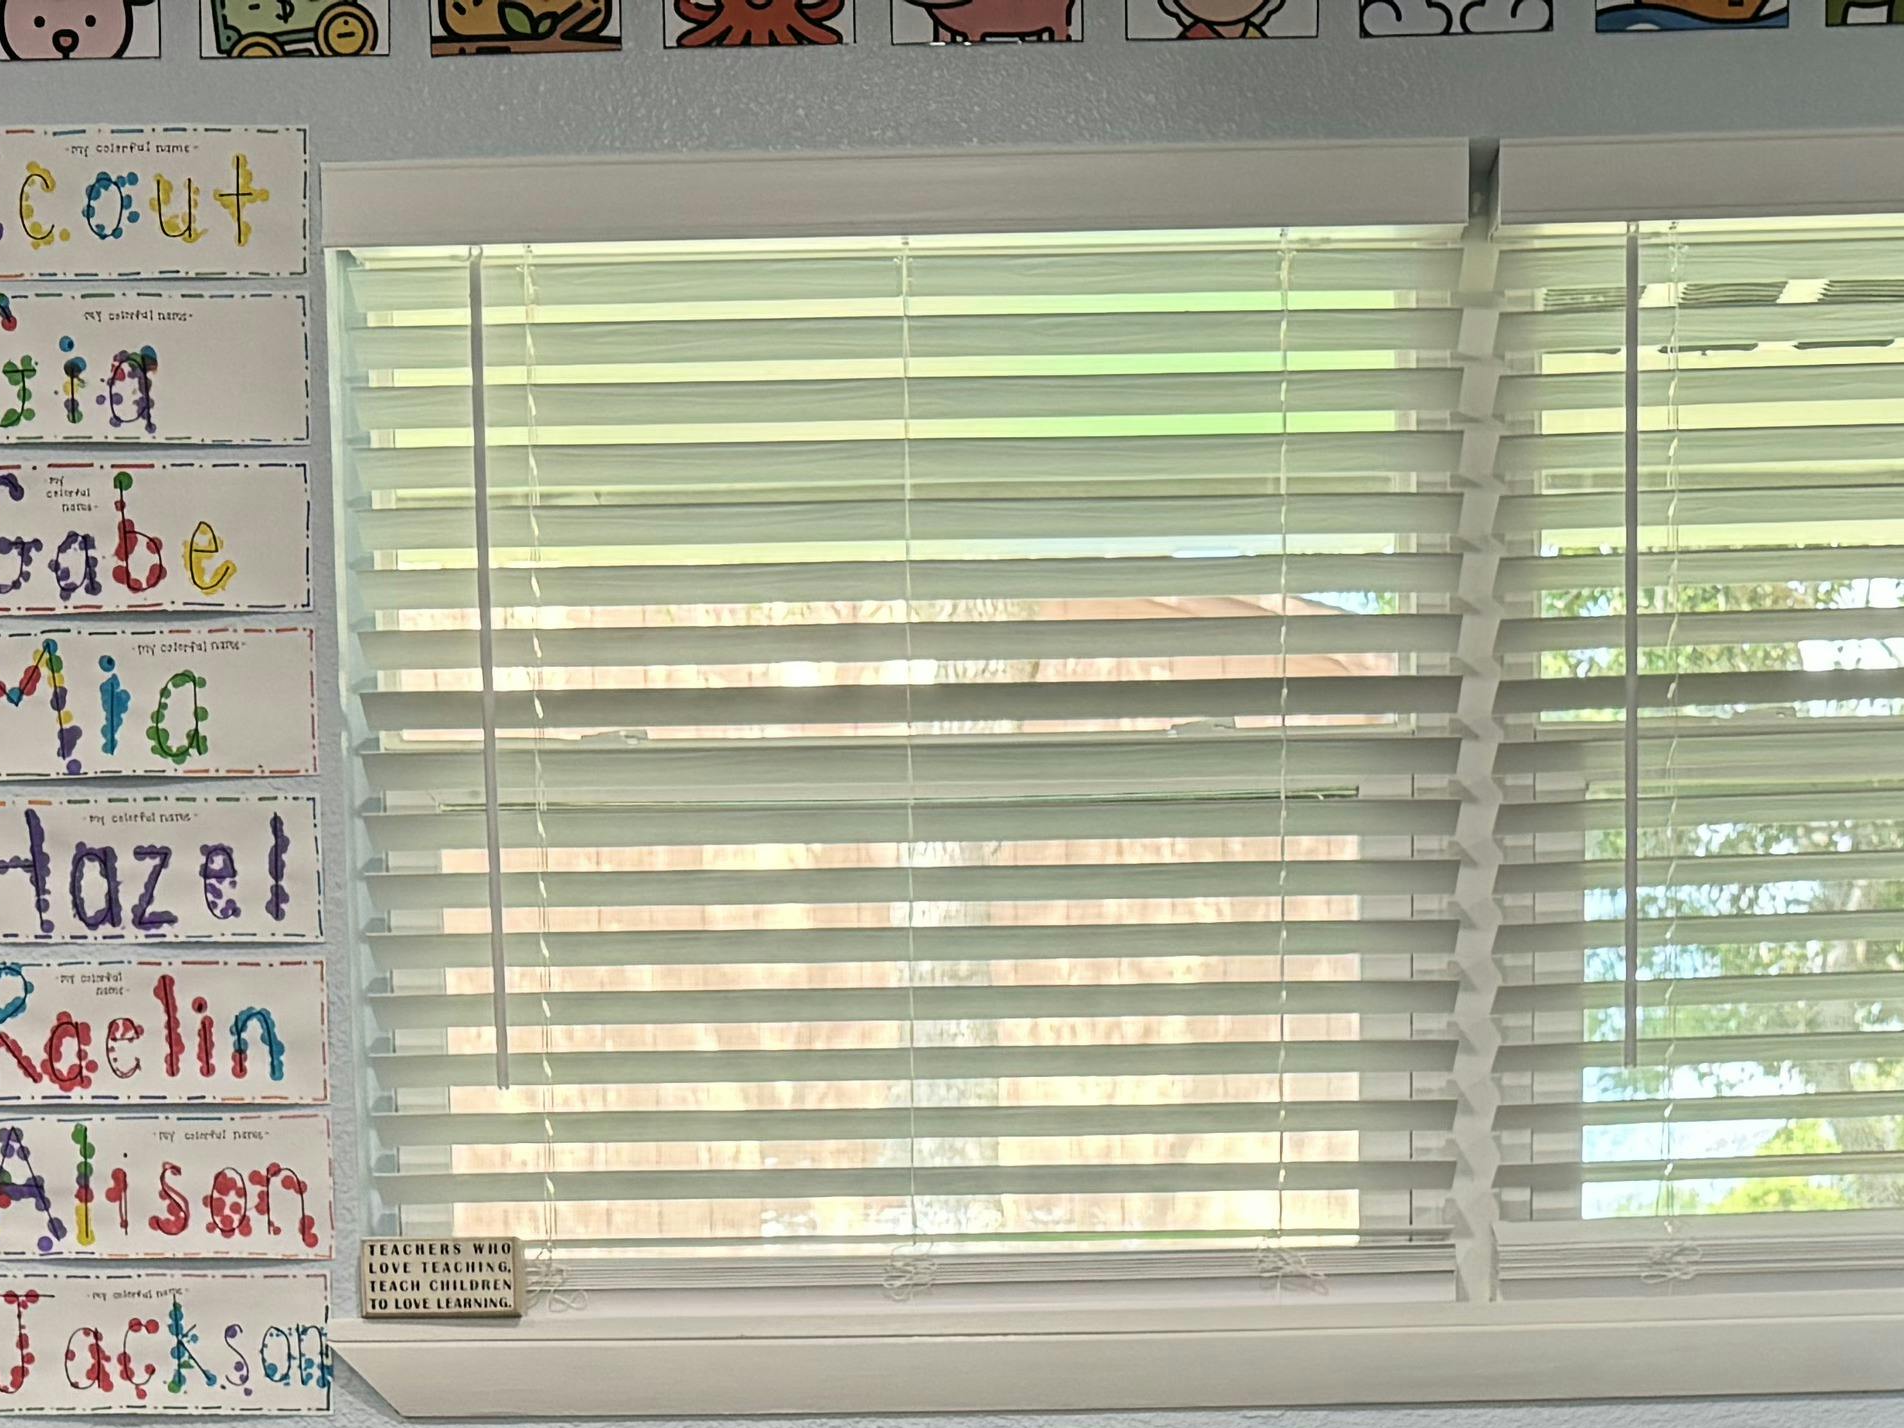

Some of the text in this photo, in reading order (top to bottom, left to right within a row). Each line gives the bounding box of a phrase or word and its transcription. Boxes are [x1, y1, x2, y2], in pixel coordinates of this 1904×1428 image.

[369, 1243, 511, 1256] TEACHERS WHO
[369, 1261, 511, 1274] LOVE TEACHING,
[370, 1279, 511, 1292] TEACH CHILDREN
[370, 1297, 511, 1310] TO LOVE LEARNING.
